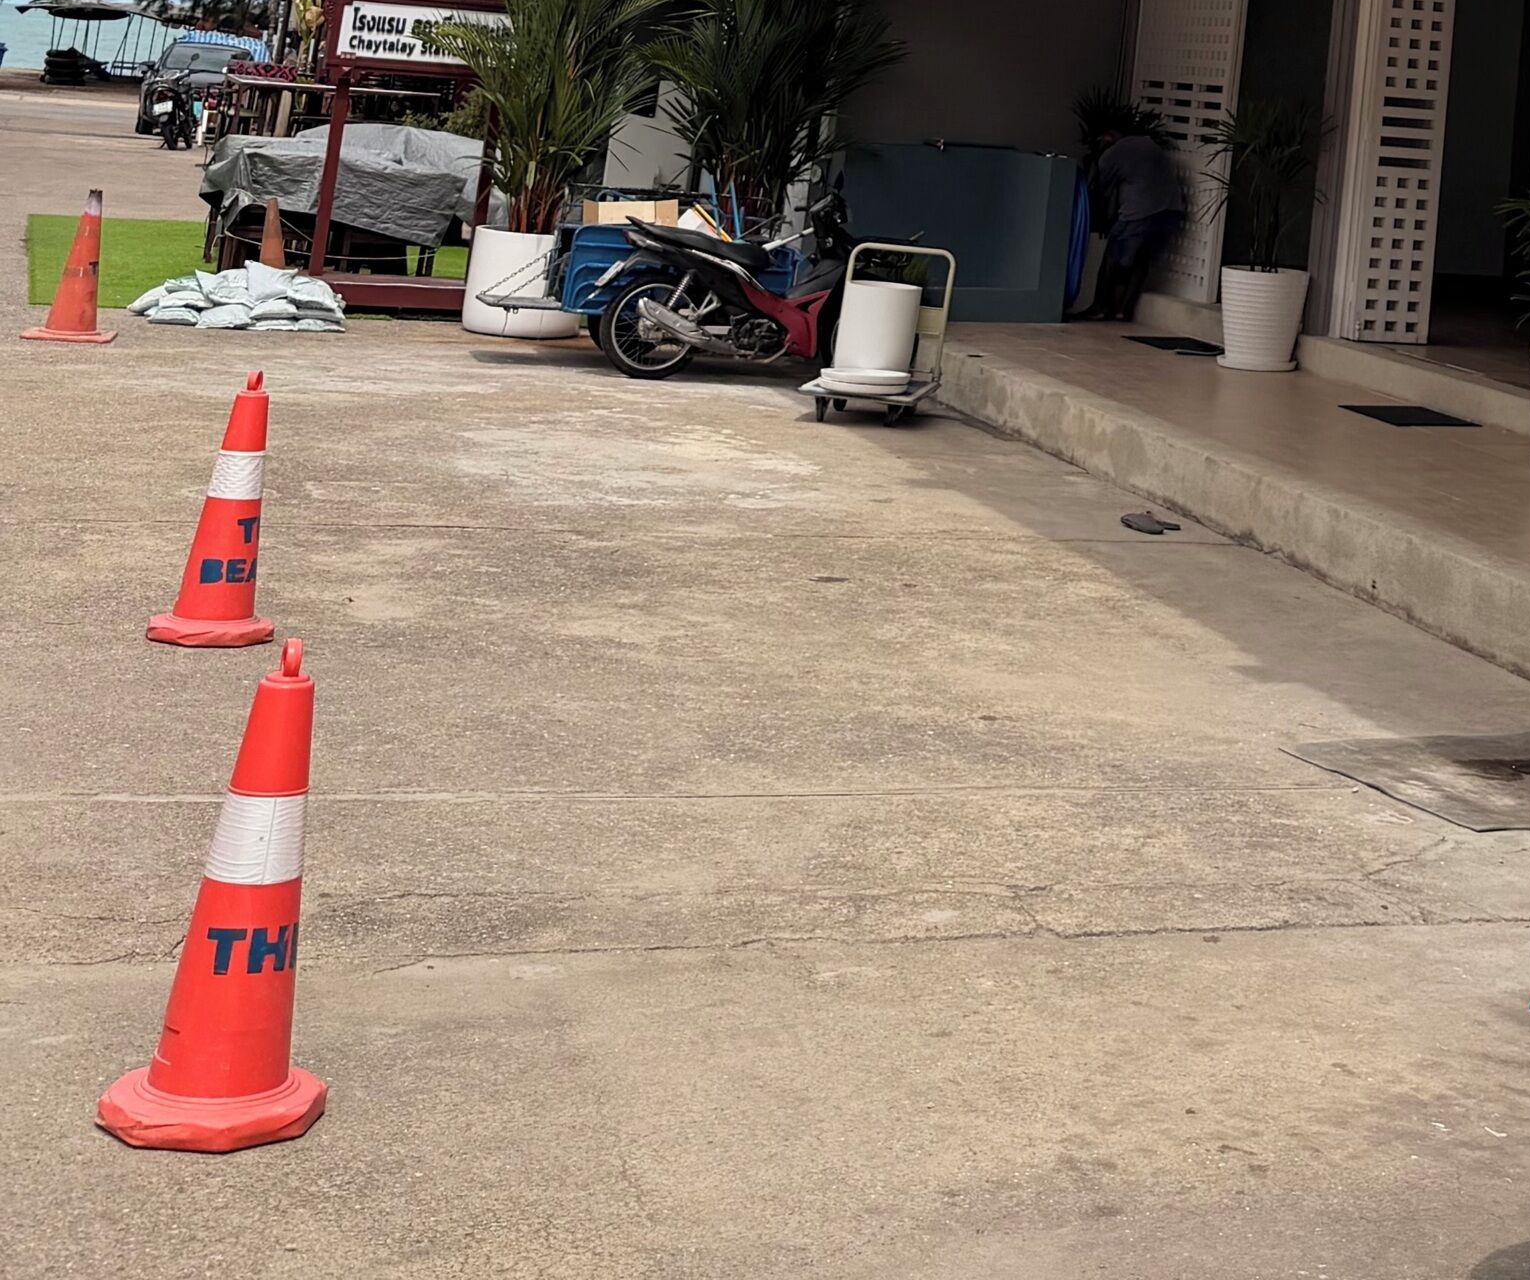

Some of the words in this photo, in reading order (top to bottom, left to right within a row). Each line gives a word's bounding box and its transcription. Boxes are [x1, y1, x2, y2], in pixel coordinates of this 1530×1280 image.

[352, 6, 407, 35] โรงแรม
[348, 35, 416, 57] Chaytalay
